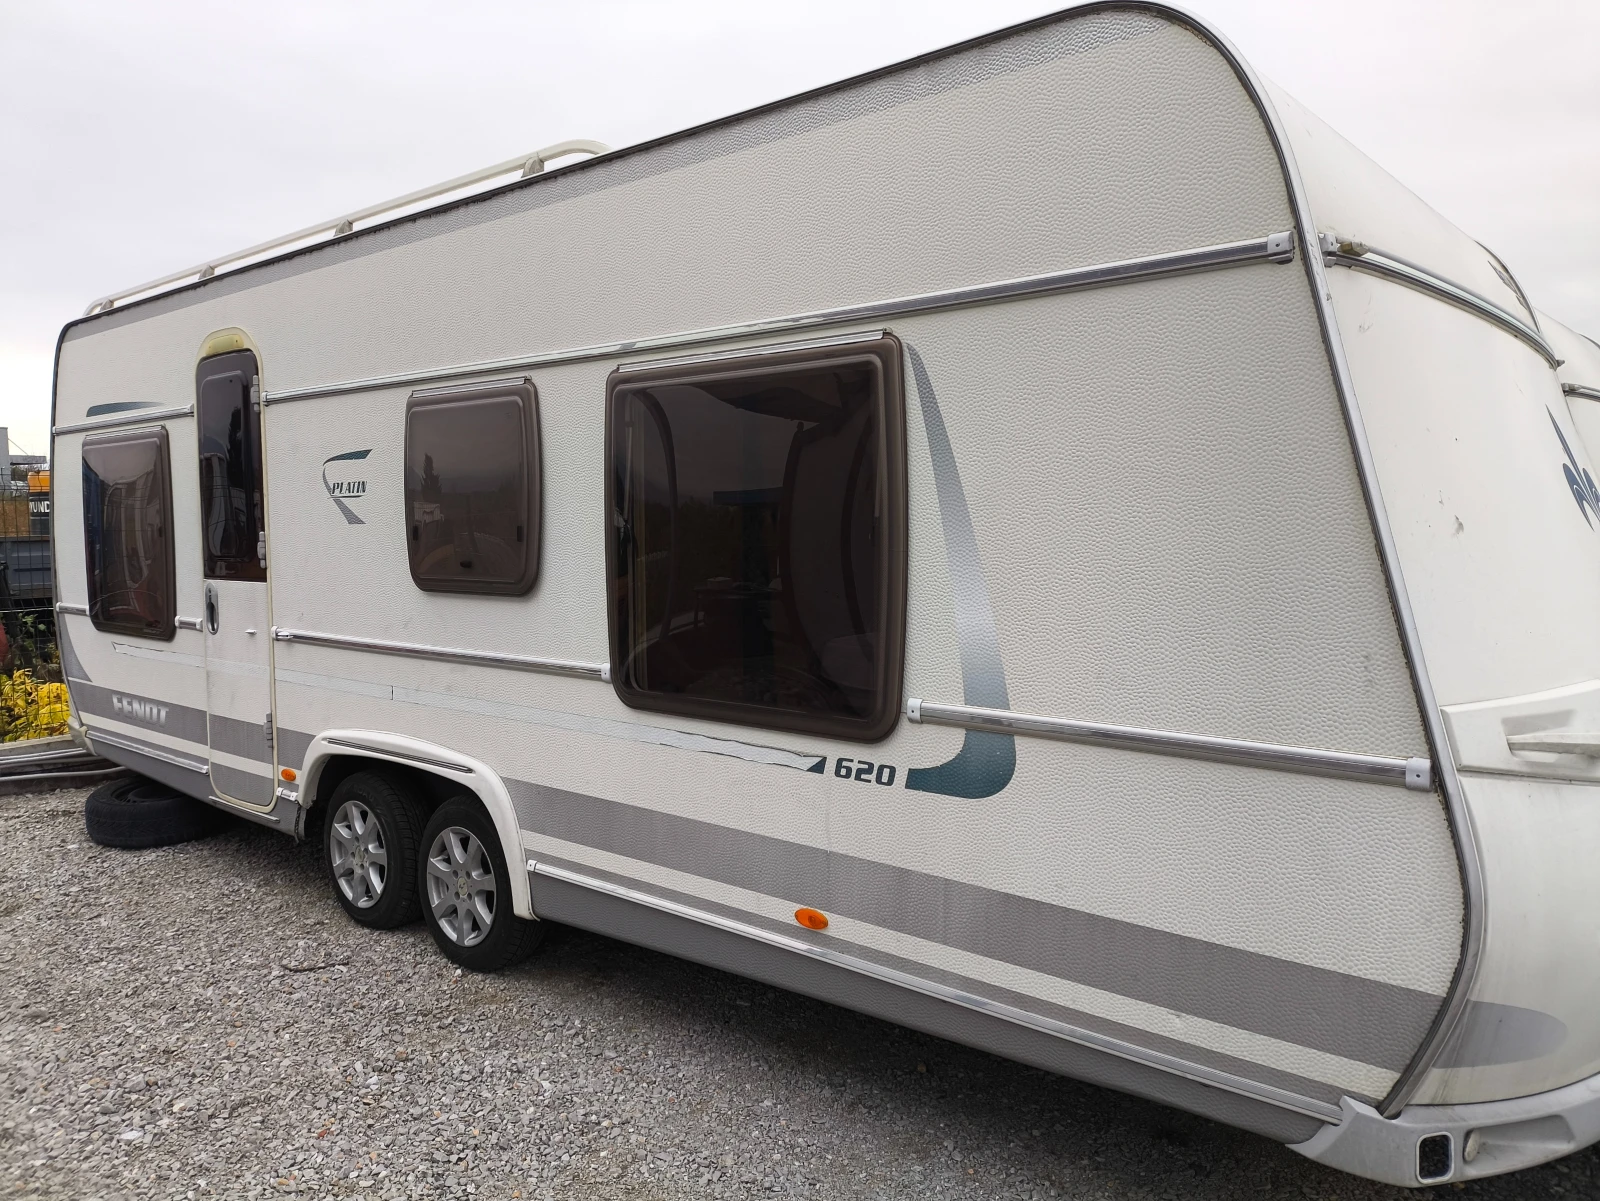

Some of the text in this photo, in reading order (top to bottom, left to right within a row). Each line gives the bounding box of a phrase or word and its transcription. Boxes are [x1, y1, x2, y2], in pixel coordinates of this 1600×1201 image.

[332, 481, 368, 494] PLATIN
[112, 693, 170, 724] FENDT
[834, 757, 897, 787] 620
